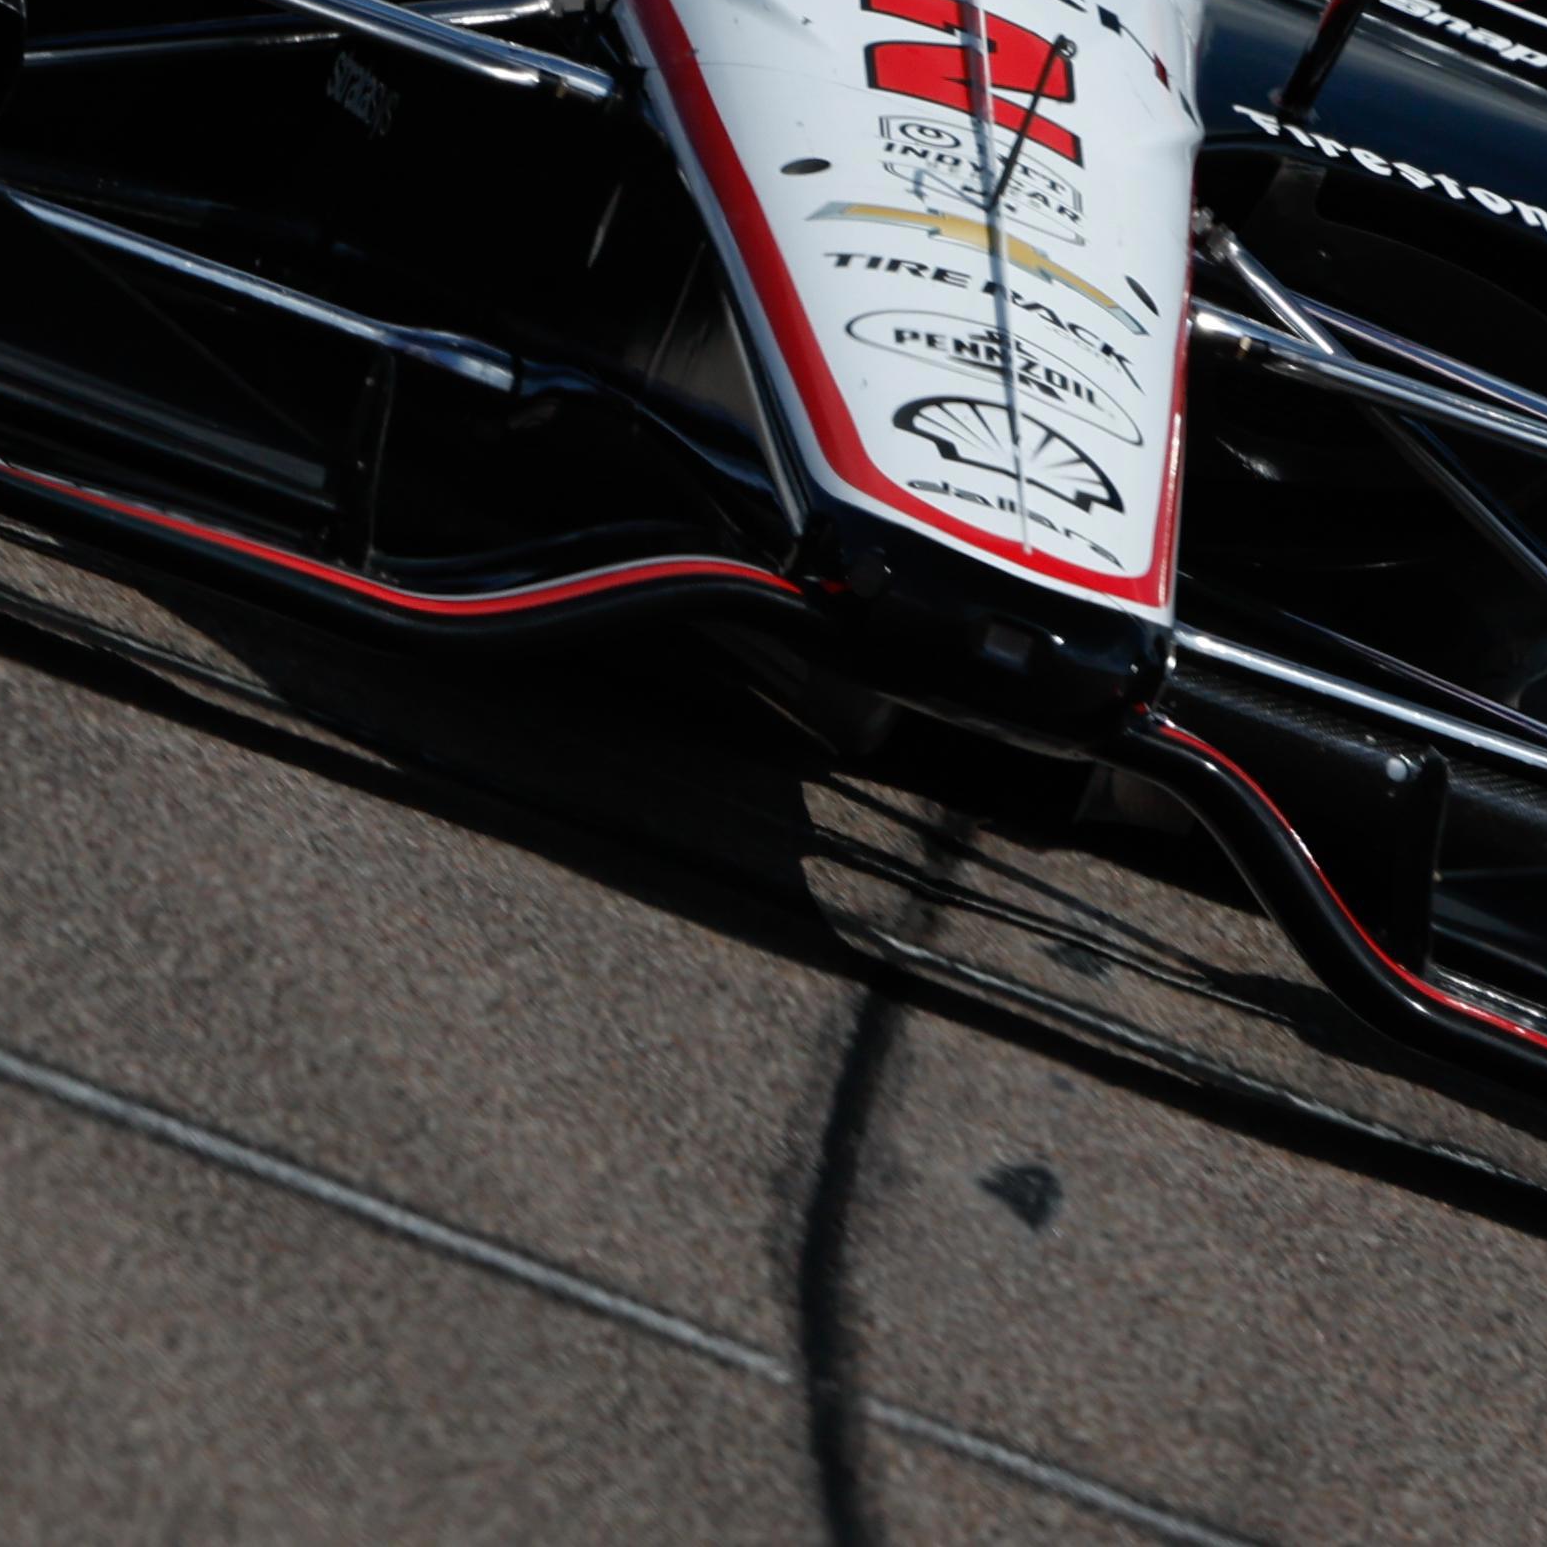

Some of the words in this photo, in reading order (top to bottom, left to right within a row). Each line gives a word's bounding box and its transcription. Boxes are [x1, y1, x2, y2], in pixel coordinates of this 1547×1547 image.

[884, 142, 1082, 225] INDYAR
[823, 251, 971, 289] TIRE
[981, 280, 1146, 397] RACK
[893, 327, 1098, 406] PENNZOIL
